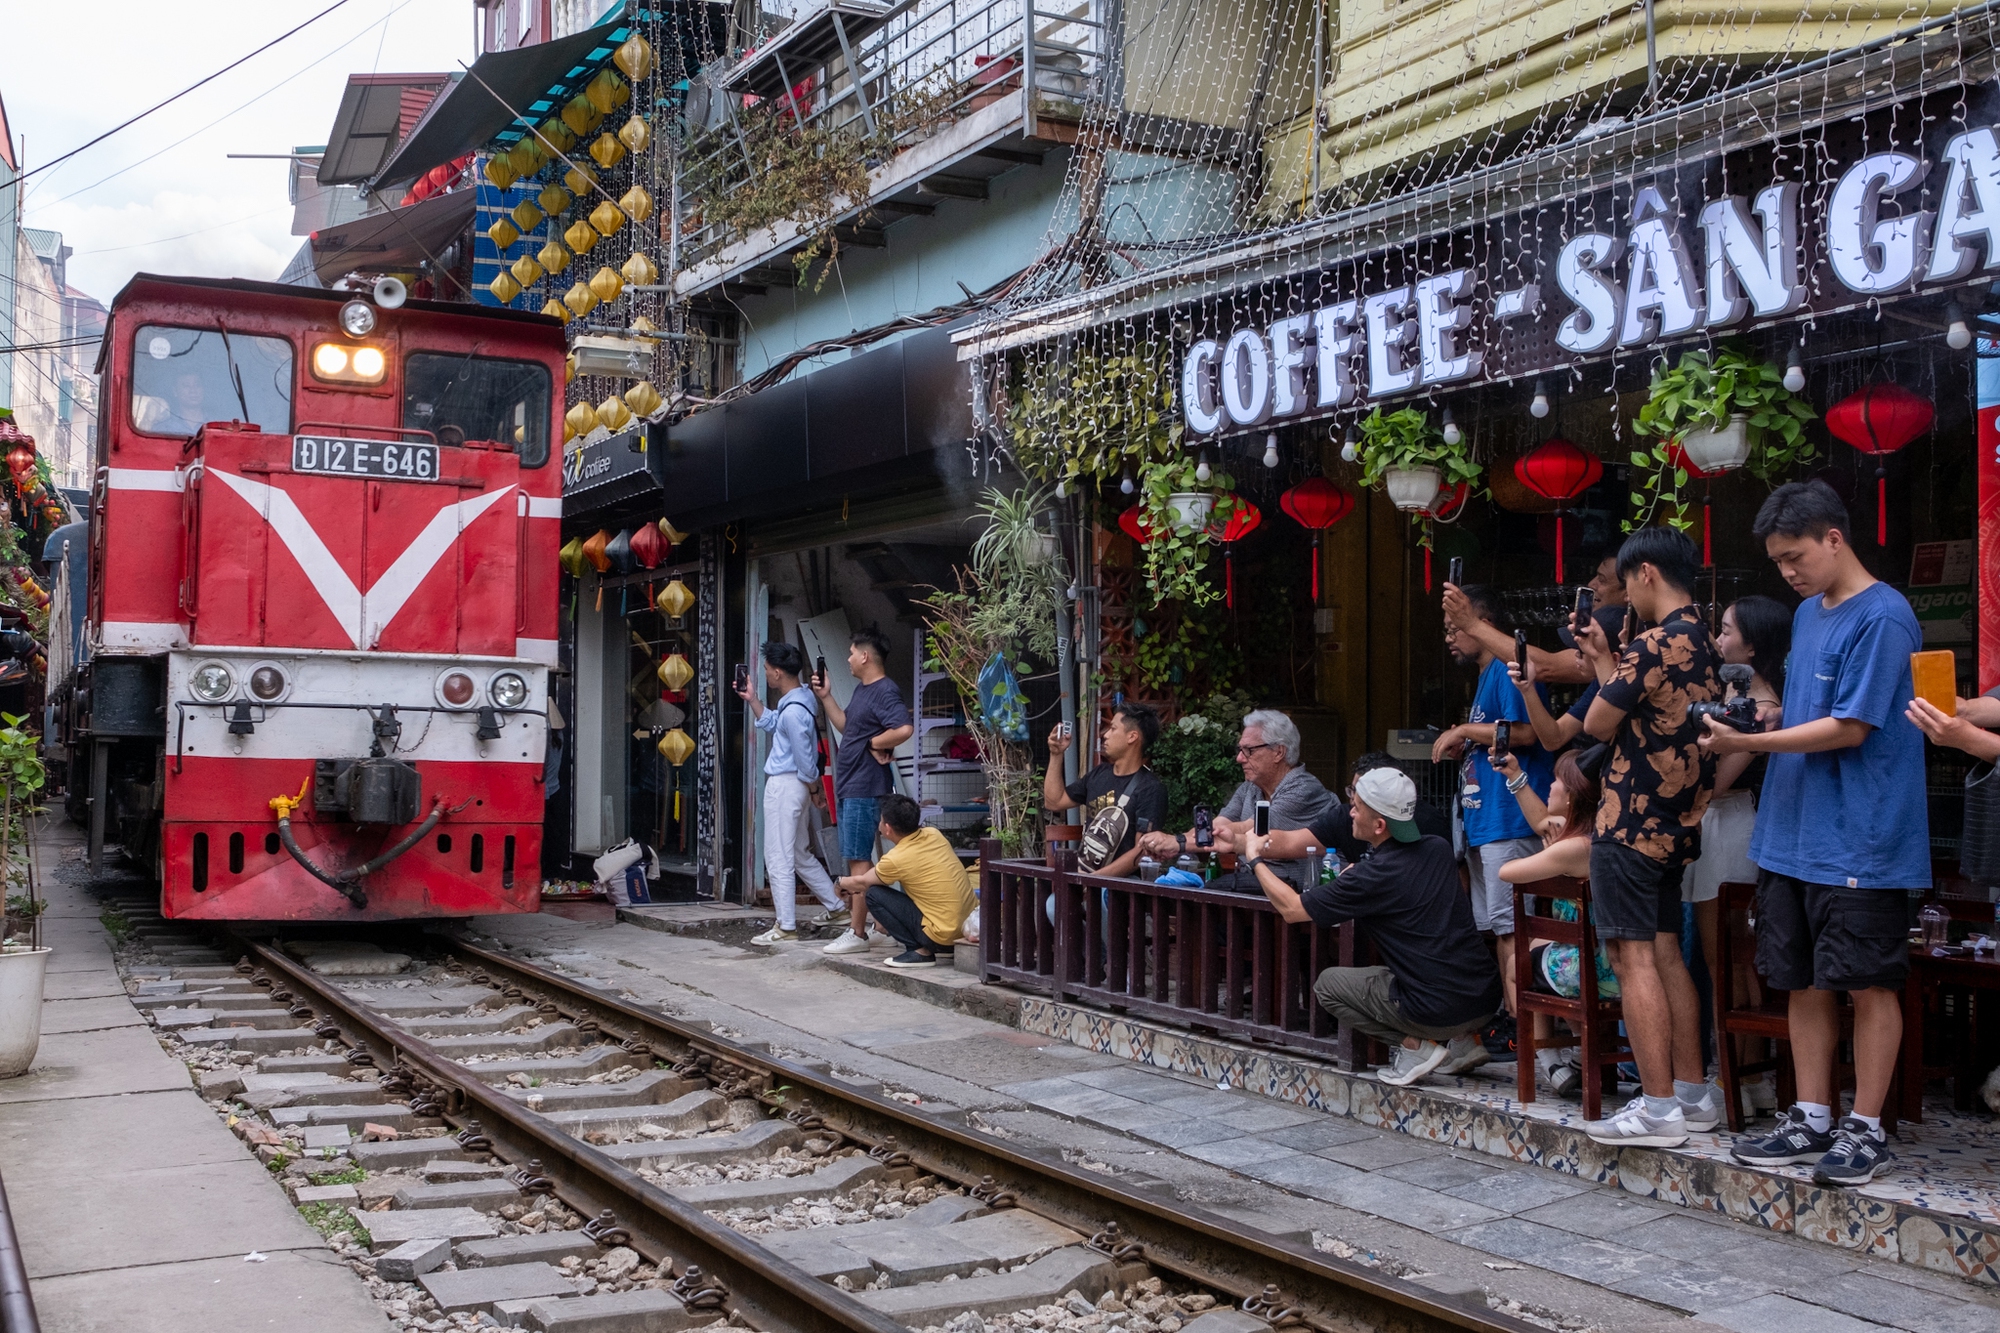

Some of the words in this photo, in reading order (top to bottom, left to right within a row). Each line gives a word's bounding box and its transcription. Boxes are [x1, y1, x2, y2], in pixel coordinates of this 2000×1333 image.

[1184, 268, 1481, 434] COFFEE
[1556, 181, 1802, 354] SÂN
[585, 456, 611, 479] coffee
